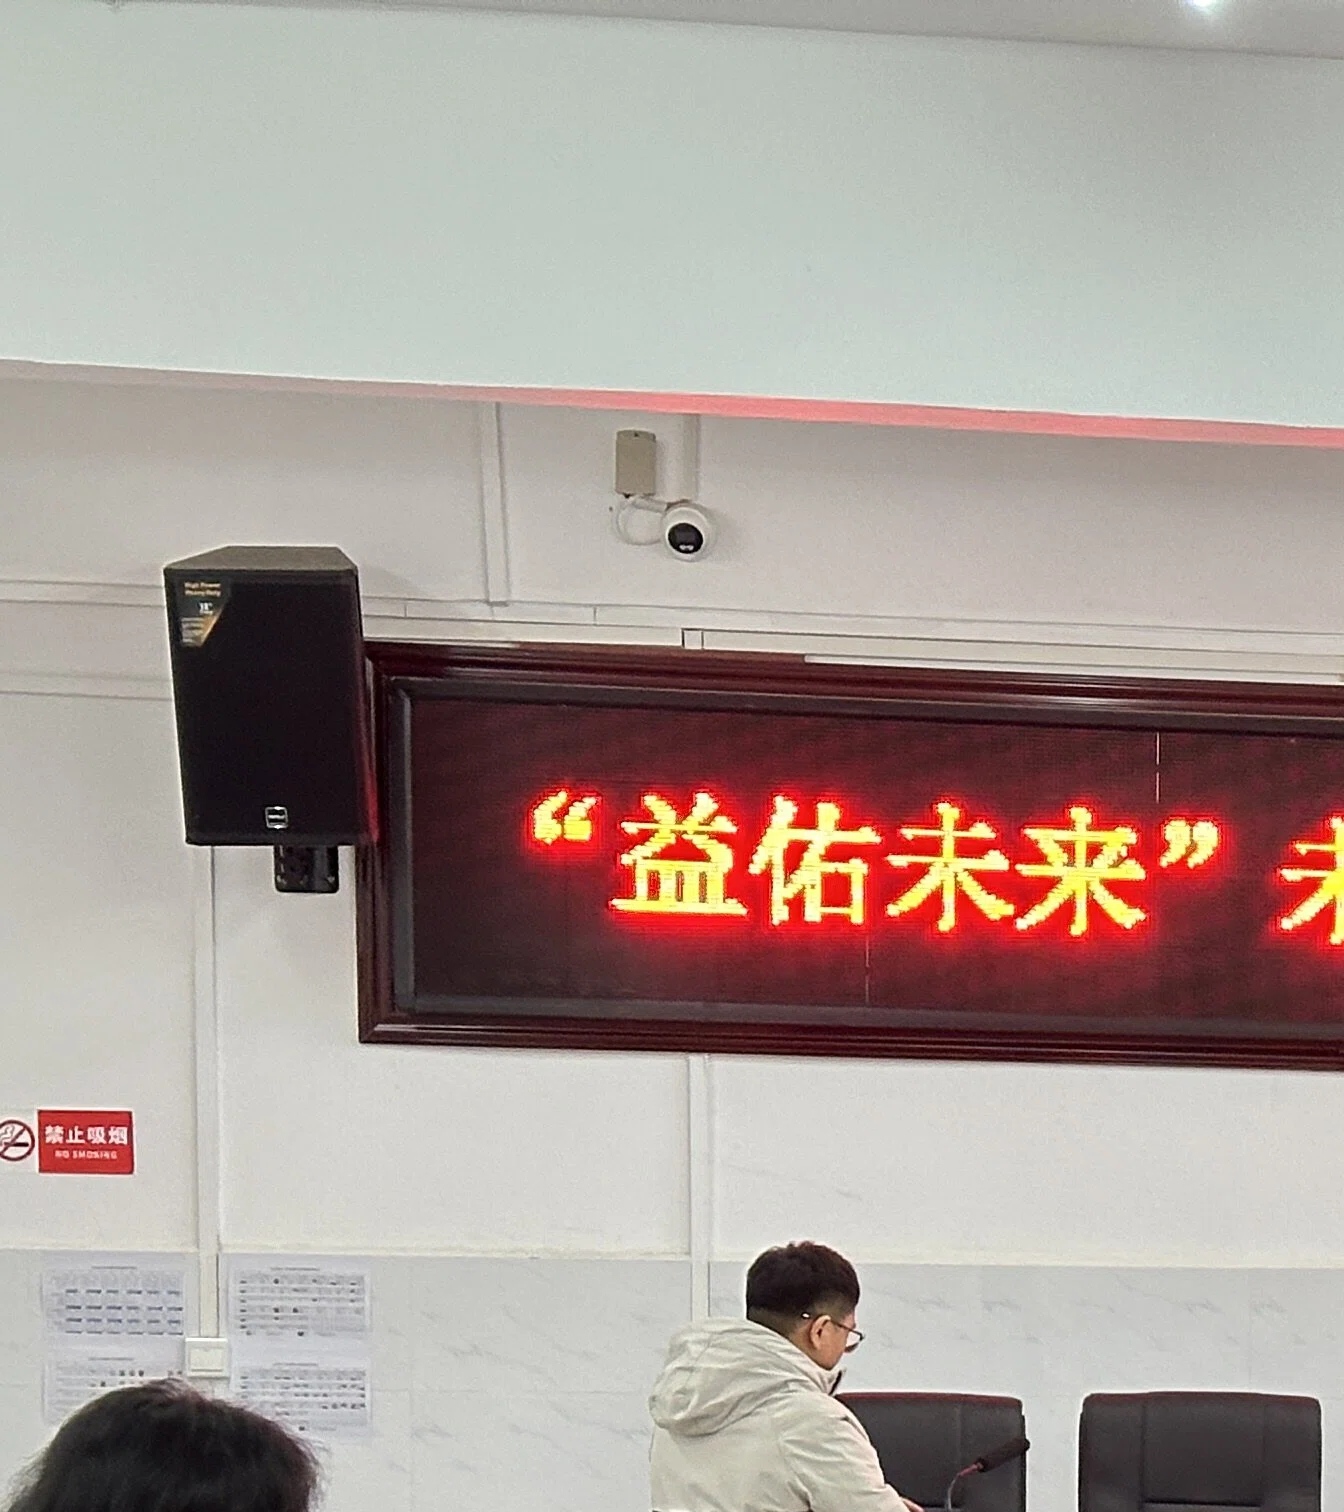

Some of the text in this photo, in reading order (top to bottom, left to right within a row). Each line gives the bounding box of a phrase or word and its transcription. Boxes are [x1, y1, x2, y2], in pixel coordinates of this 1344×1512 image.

[532, 792, 1219, 935] “益佑未来”
[45, 1125, 128, 1145] 禁止吸烟
